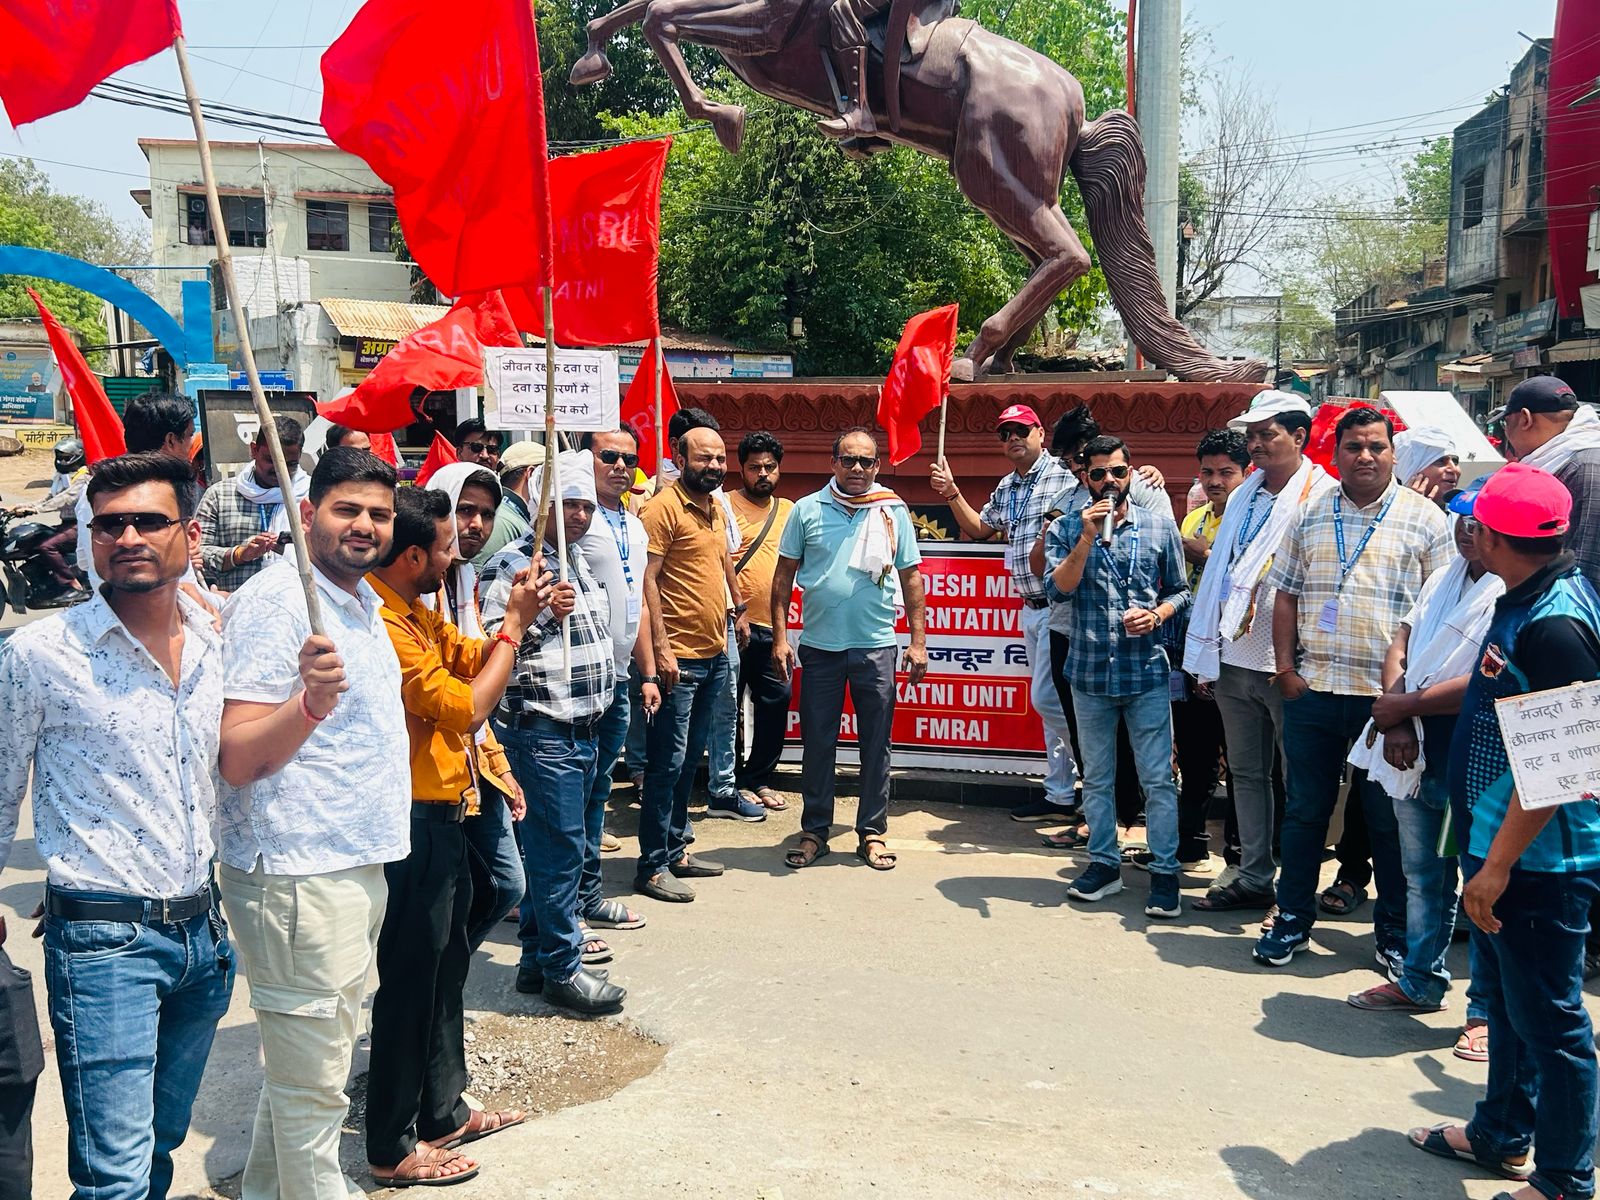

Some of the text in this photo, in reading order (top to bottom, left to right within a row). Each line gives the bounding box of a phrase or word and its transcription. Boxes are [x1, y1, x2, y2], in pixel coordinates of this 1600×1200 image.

[537, 278, 604, 302] ATNI
[502, 361, 532, 372] जीवन
[563, 364, 581, 374] दवा
[584, 363, 599, 374] एवं
[512, 383, 531, 393] दवा
[514, 404, 538, 414] GST
[569, 404, 589, 415] करो
[921, 574, 1021, 598] DESH ME
[894, 605, 1024, 632] PRNTATIV
[902, 646, 995, 671] जदूर
[963, 685, 1017, 708] UNIT
[915, 717, 989, 742] FMRAI
